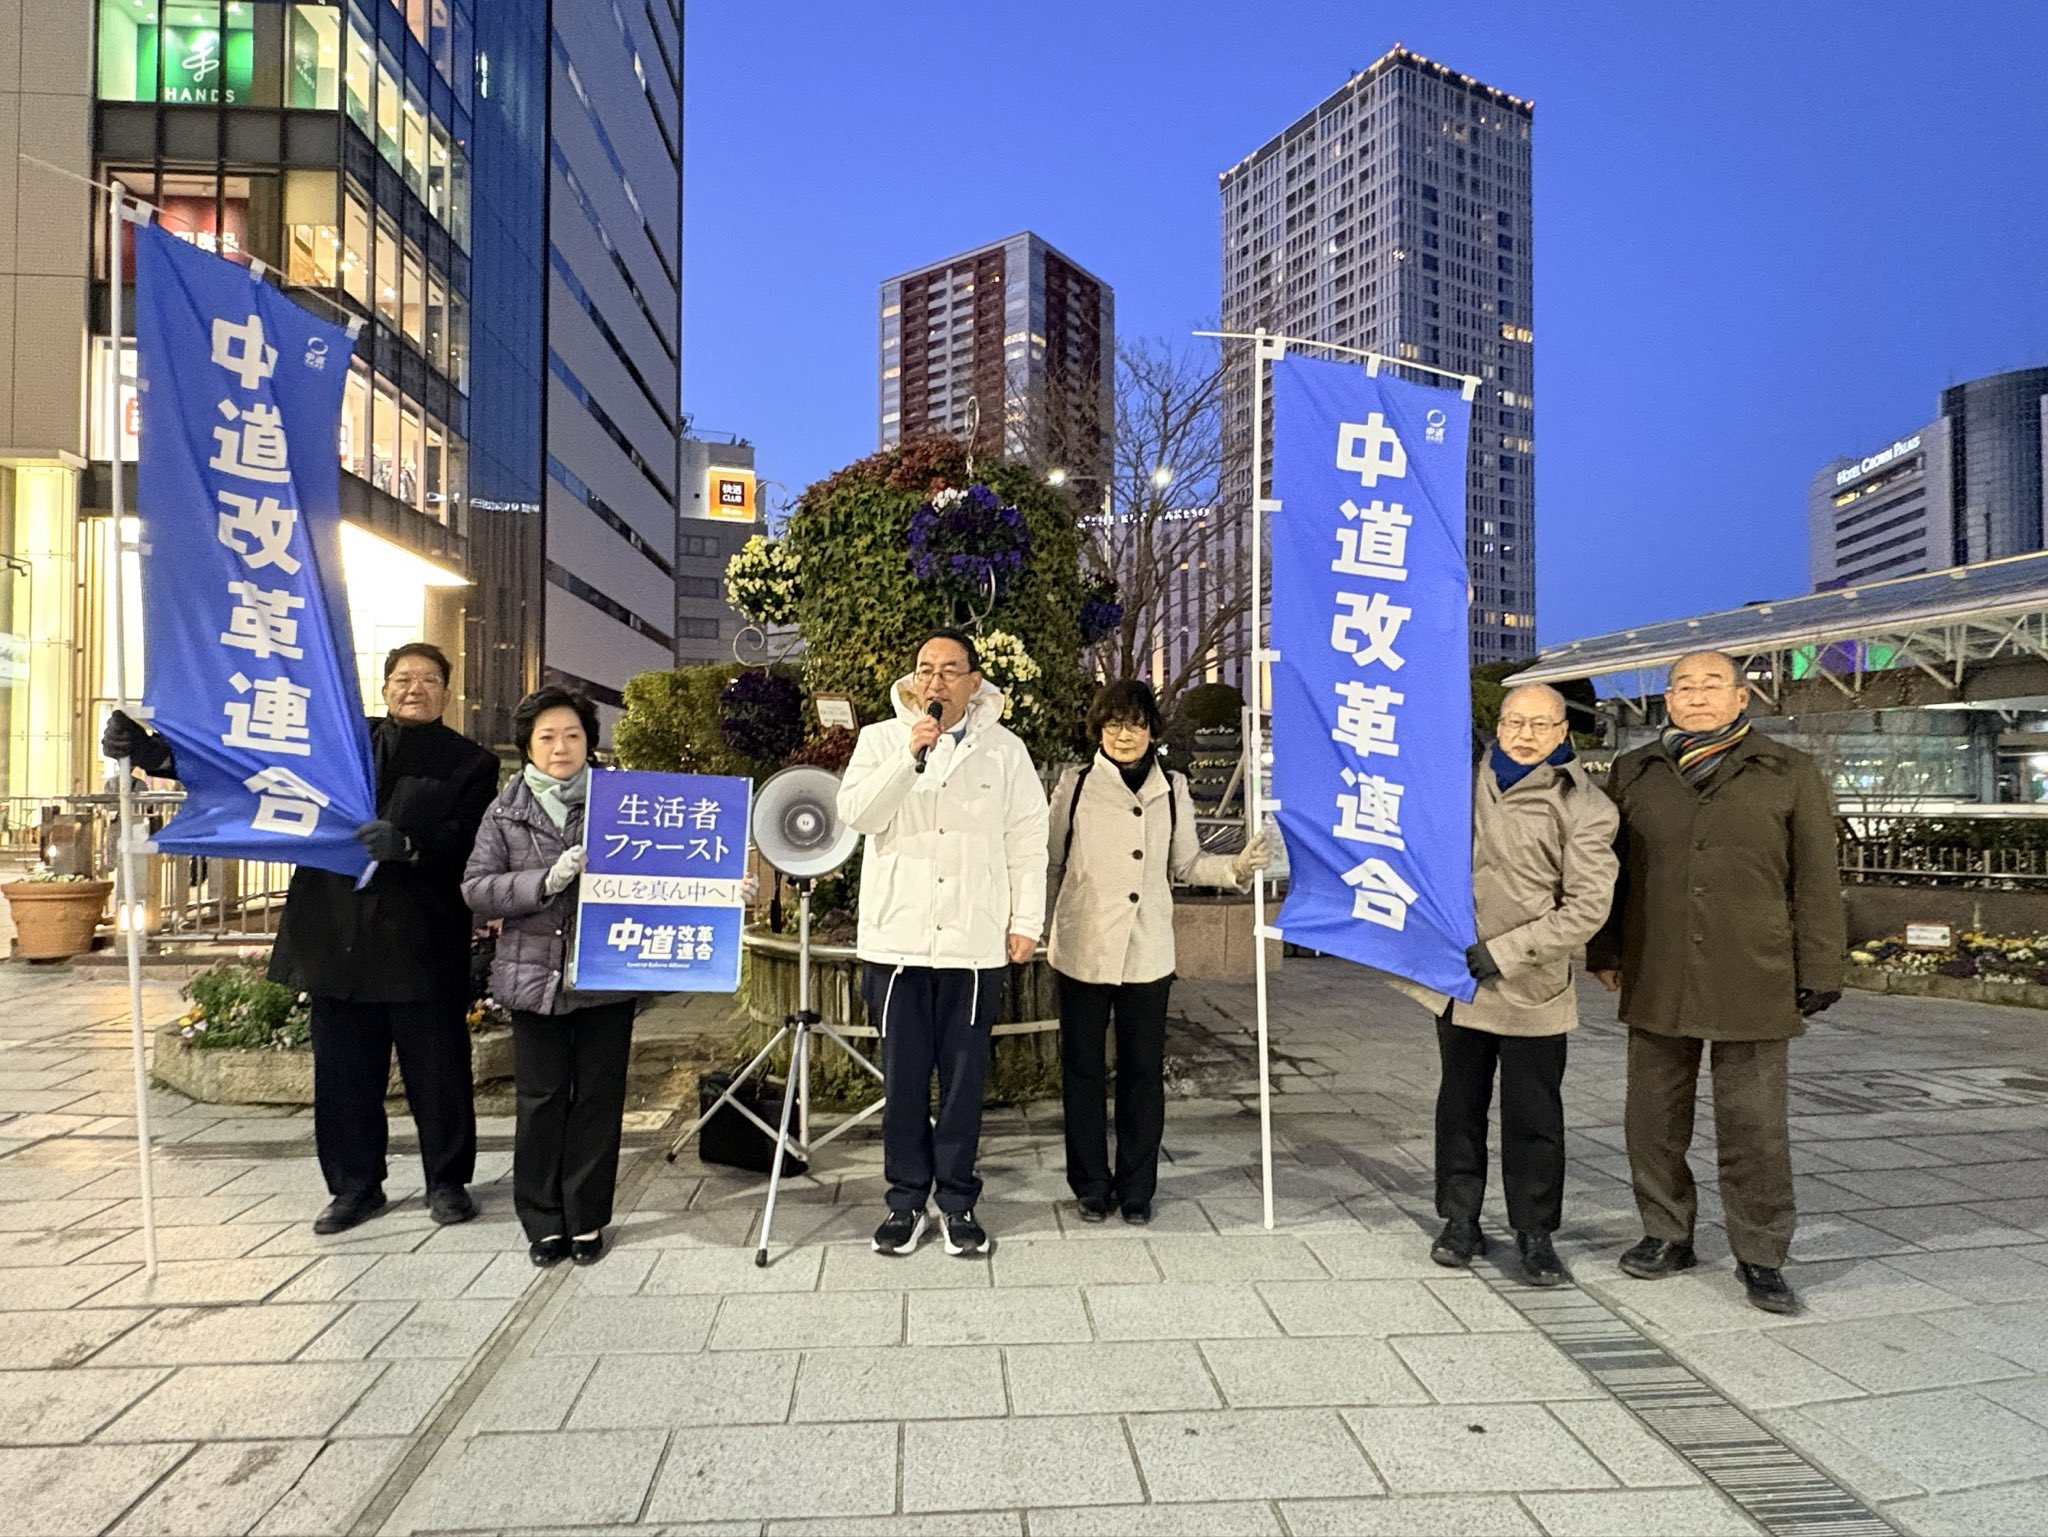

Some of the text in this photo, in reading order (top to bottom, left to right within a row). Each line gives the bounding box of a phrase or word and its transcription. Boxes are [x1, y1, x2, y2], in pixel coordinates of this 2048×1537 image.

[165, 87, 235, 103] HANDS
[722, 494, 742, 503] CLUB
[209, 314, 330, 838] 中道改革連合
[1331, 412, 1419, 931] 中道改革連合
[616, 793, 722, 830] 生活者
[604, 834, 730, 864] ファースト
[591, 878, 736, 903] くらしを真ん中へ！
[607, 917, 677, 960] 中道
